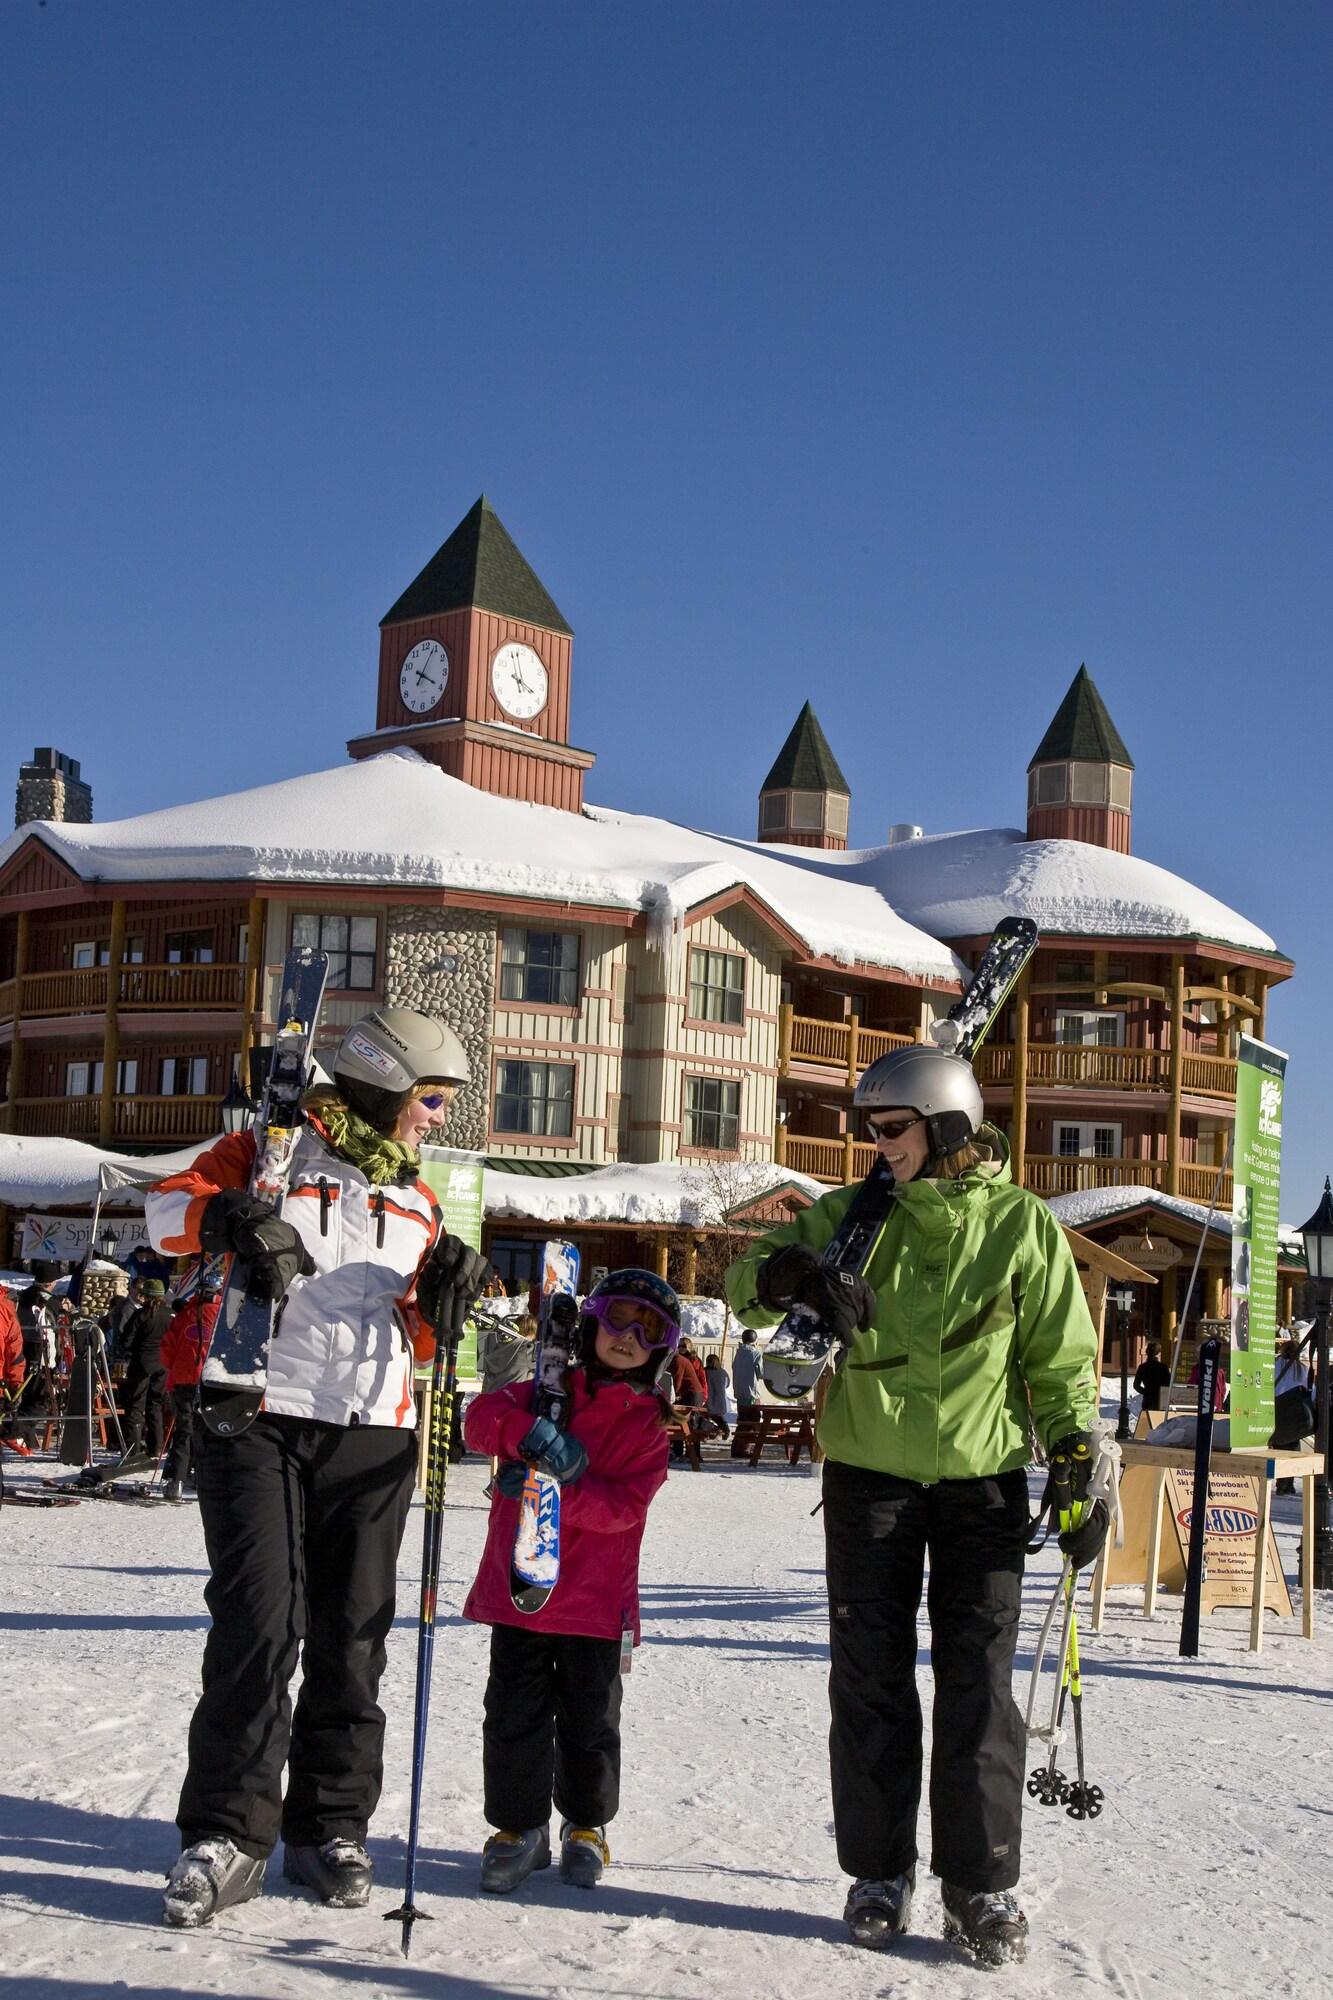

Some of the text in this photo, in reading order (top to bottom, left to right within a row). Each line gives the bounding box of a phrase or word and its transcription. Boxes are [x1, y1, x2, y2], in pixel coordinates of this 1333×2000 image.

[421, 642, 431, 651] 12
[434, 644, 438, 653] 1
[412, 650, 419, 658] 11
[440, 654, 445, 662] 2
[405, 662, 413, 671] 10
[442, 668, 447, 676] 3
[401, 676, 406, 684] 9
[437, 683, 443, 691] 4
[404, 690, 409, 698] 8
[411, 700, 416, 708] 7
[430, 696, 436, 704] 5
[420, 702, 425, 710] 6
[459, 1191, 480, 1202] GAMES
